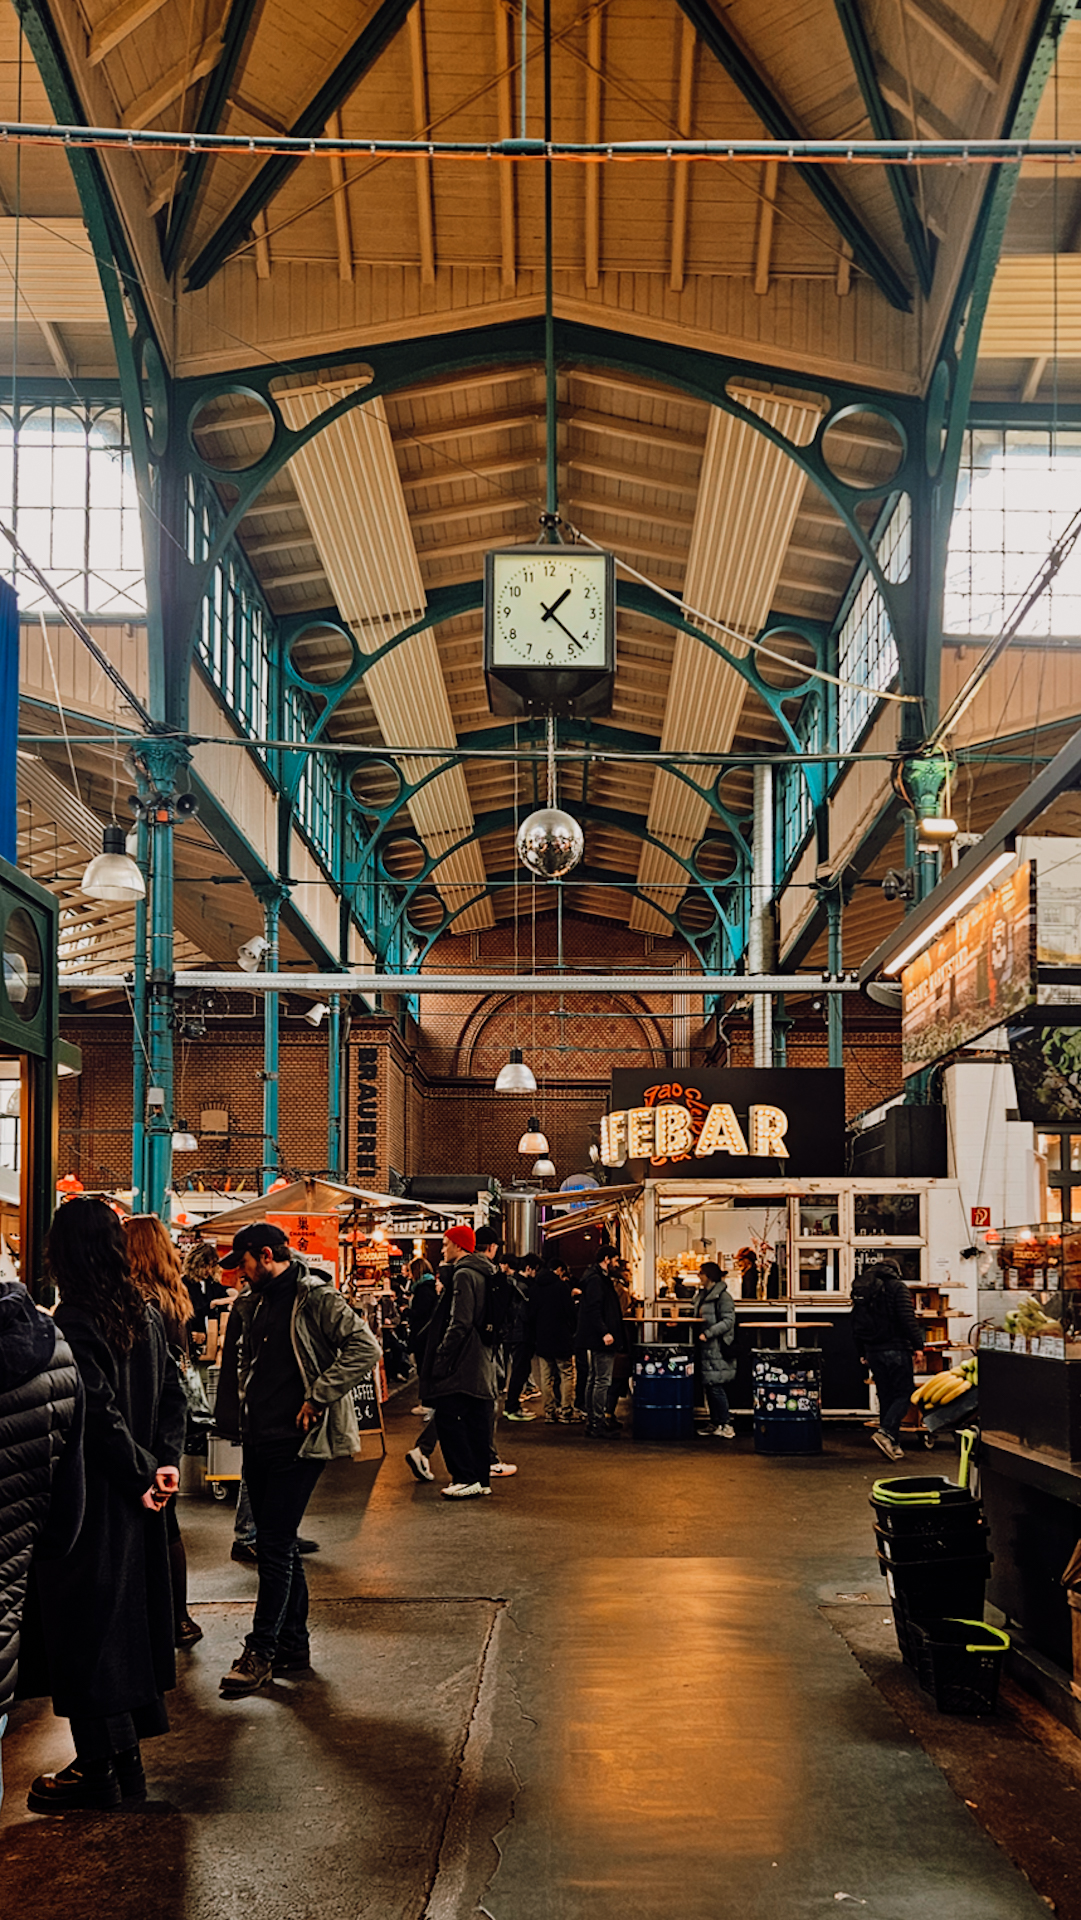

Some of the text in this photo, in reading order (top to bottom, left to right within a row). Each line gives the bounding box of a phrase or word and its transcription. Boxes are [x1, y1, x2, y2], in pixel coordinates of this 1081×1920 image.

[544, 565, 555, 577] 12
[524, 572, 533, 583] 11
[569, 573, 574, 584] 1
[509, 586, 521, 597] 10
[584, 587, 590, 599] 2
[504, 606, 511, 618] 9
[589, 608, 596, 620] 3
[509, 628, 517, 639] 8
[582, 630, 589, 640] 4
[526, 643, 532, 655] 7
[546, 649, 553, 660] 6
[568, 643, 574, 655] 5
[357, 1048, 378, 1177] BRAUEREI
[600, 1103, 790, 1168] FEBAR
